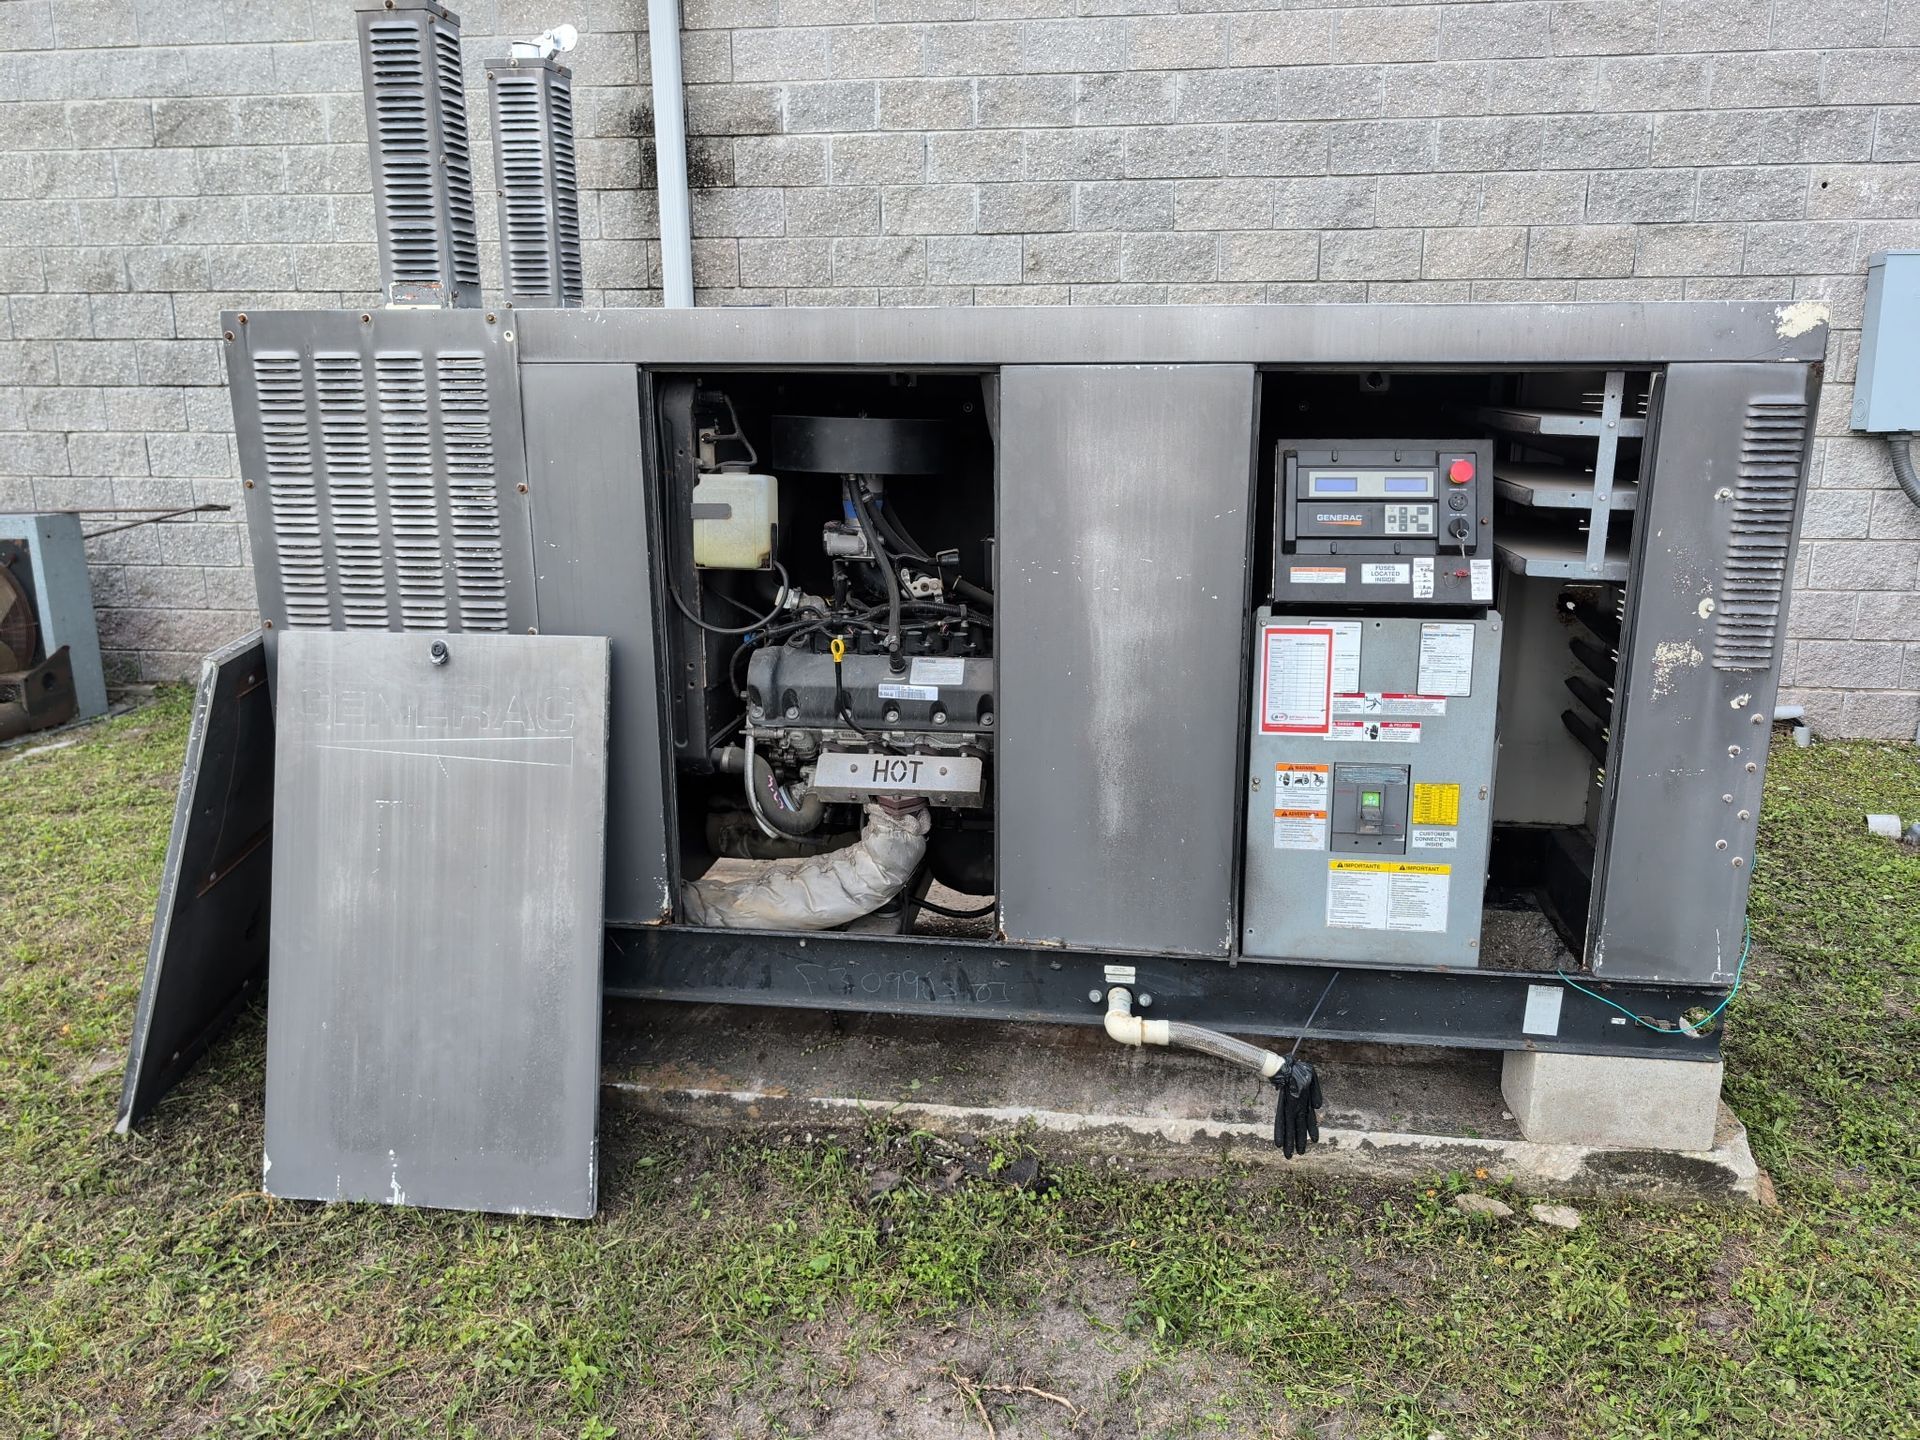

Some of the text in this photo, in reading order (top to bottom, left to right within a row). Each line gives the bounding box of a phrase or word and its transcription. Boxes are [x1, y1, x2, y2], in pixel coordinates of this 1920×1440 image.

[1316, 513, 1363, 522] GENERAC
[872, 758, 924, 784] HOT
[1343, 862, 1381, 870] IMPORTANTE
